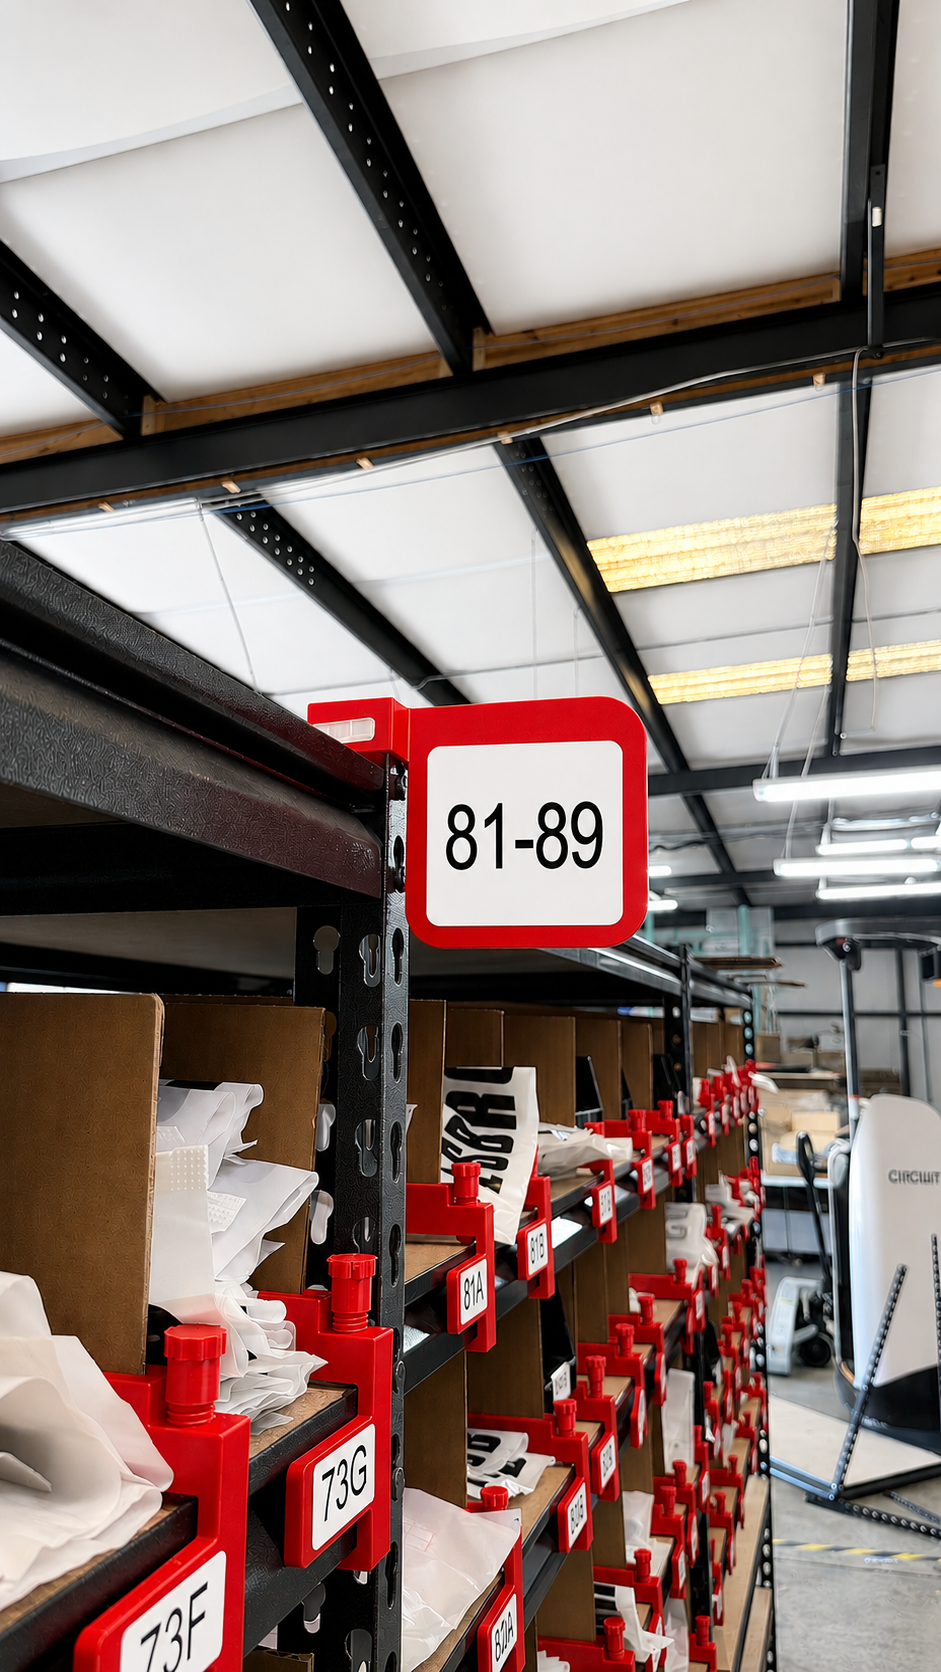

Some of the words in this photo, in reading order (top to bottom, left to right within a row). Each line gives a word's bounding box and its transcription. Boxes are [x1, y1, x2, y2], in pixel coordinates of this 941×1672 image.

[446, 801, 603, 870] 81-89
[530, 1233, 545, 1264] 81B
[463, 1271, 484, 1310] 81A
[321, 1444, 367, 1522] 73G
[140, 1581, 208, 1672] 73F
